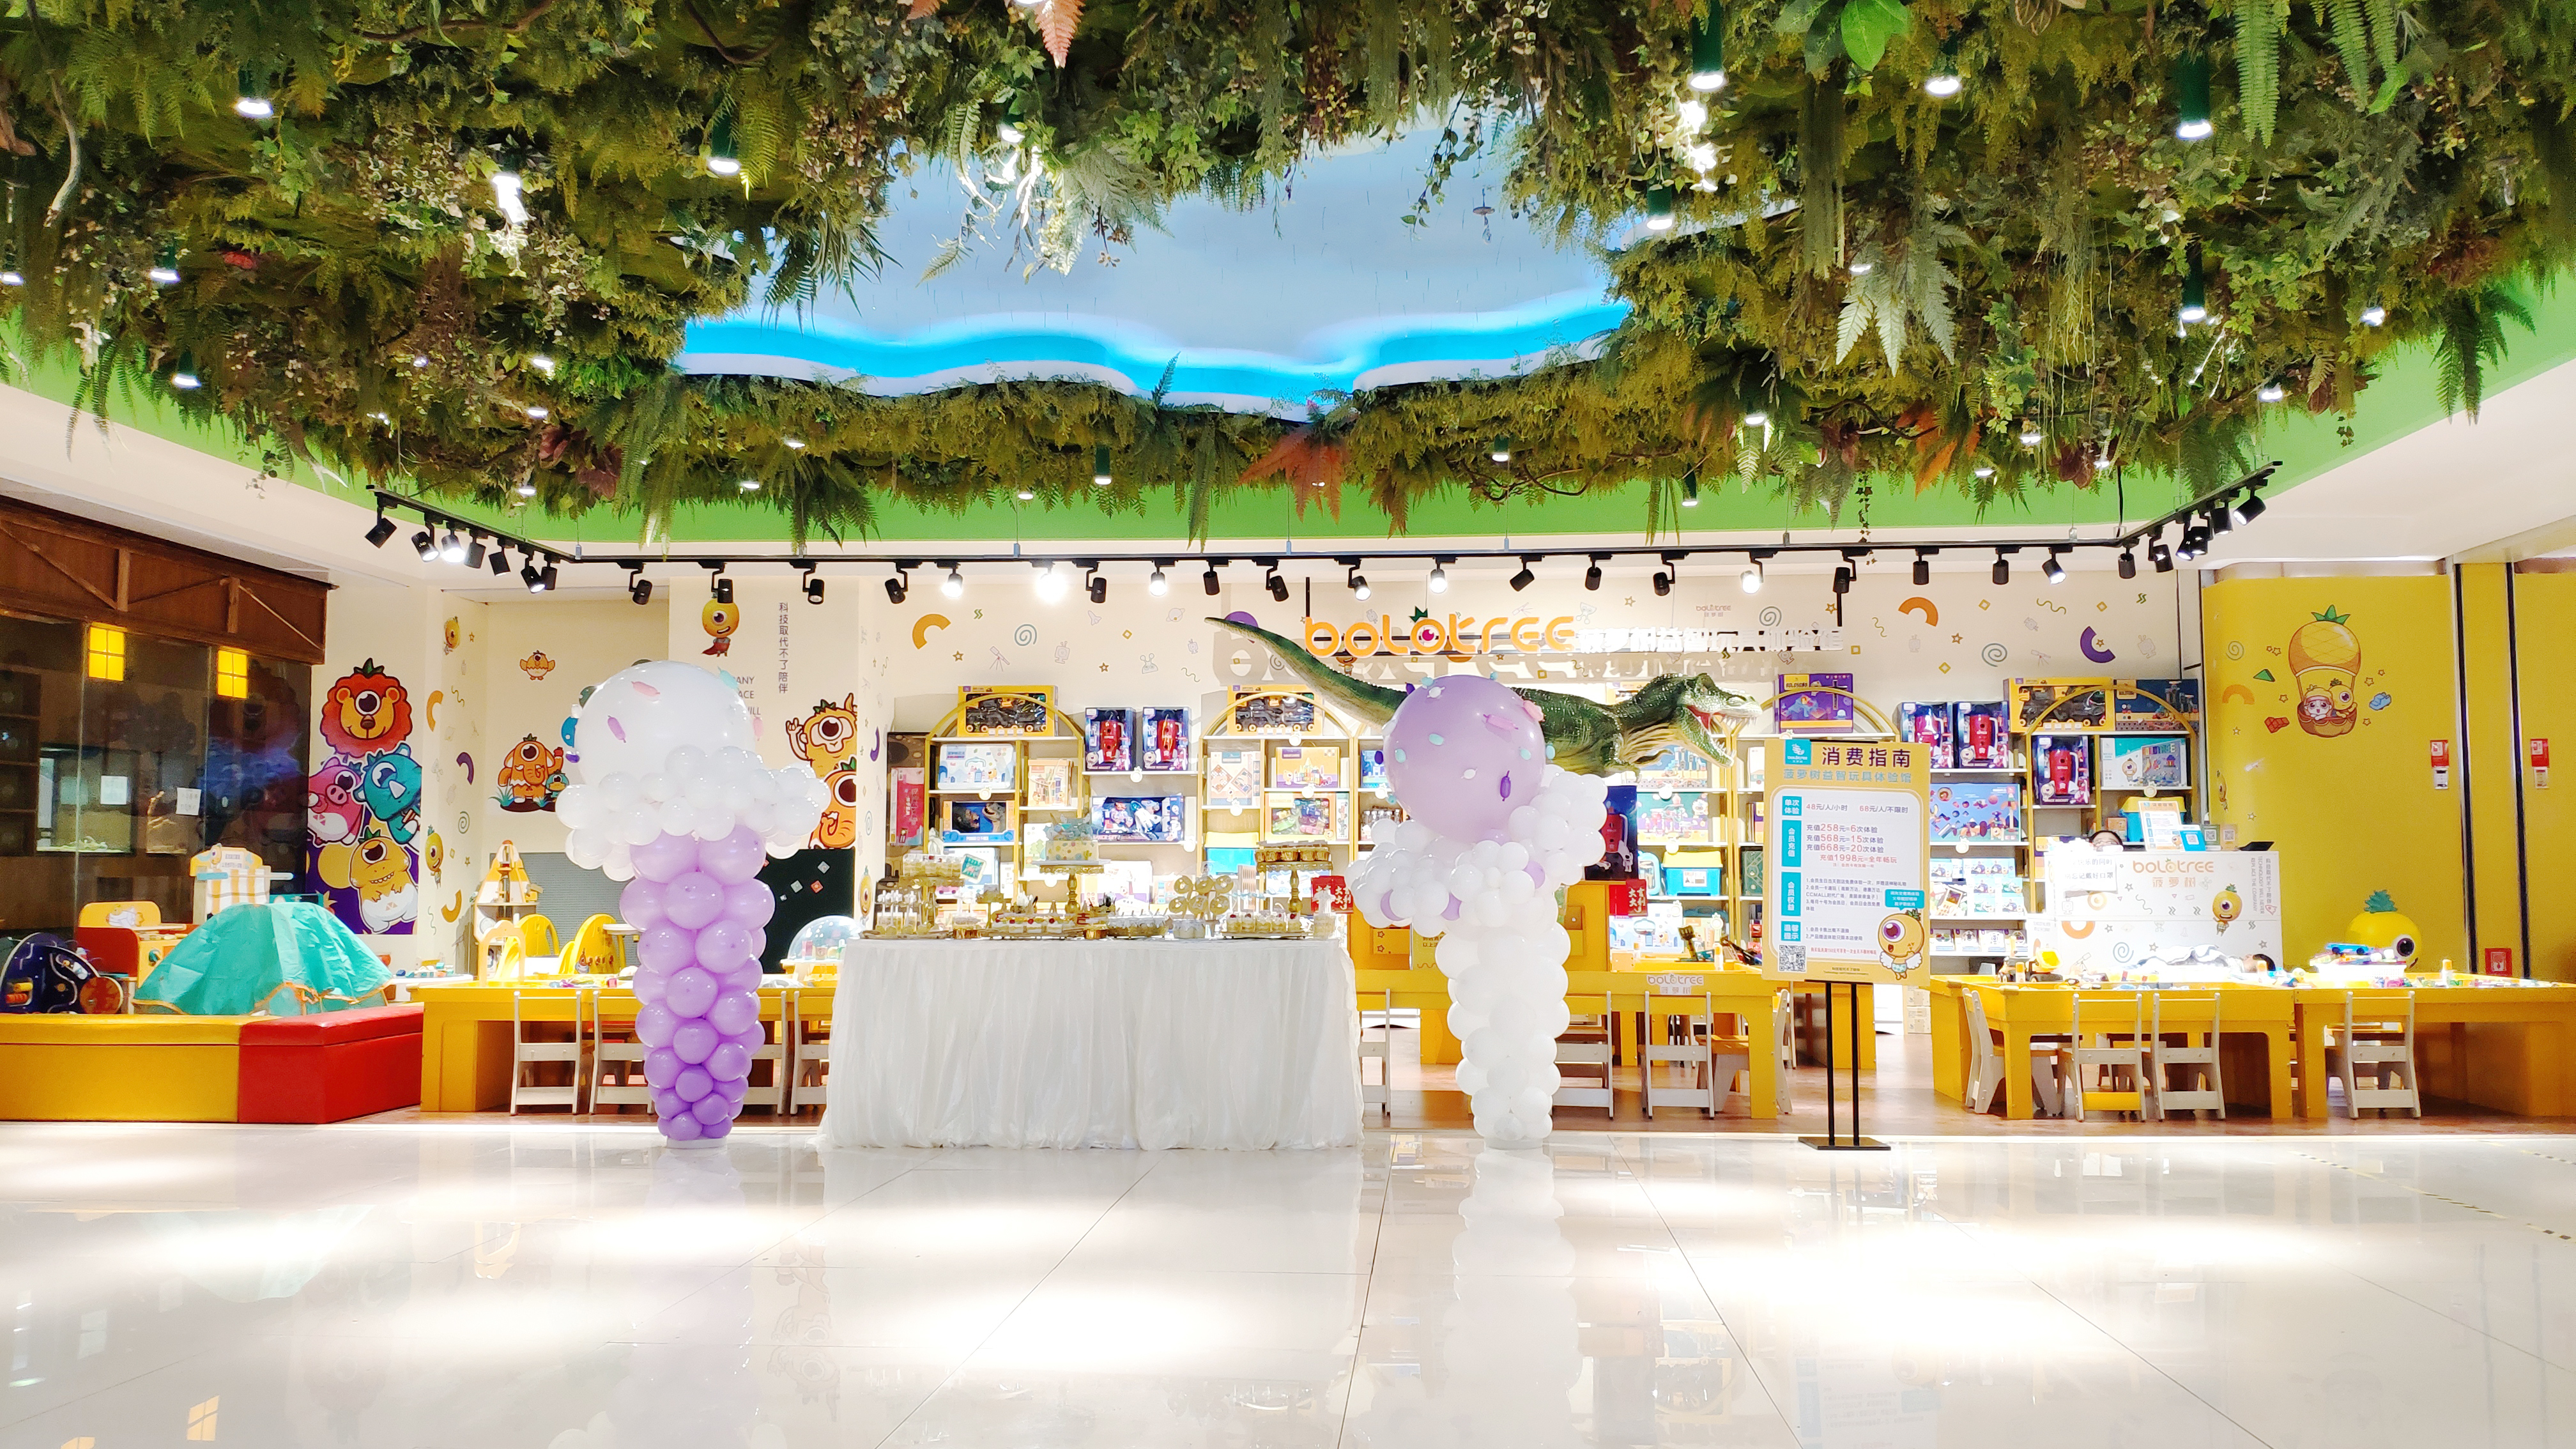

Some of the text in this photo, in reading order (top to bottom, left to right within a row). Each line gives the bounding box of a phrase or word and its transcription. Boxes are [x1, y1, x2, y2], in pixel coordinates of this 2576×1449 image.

[778, 602, 789, 694] 科技取代不了陪伴
[1822, 746, 1911, 768] 消费指南
[1784, 769, 1912, 783] 菠萝树益智玩具体验馆
[1806, 803, 1908, 814] 48元/人/小时 68元/人/不限时
[1806, 824, 1878, 834] 充值258元=6次体验
[1806, 834, 1883, 844] 充值568元=15次体验
[1806, 843, 1884, 854] 充值668元=20次体验
[1820, 854, 1897, 864] 充值1998元=全年畅玩
[2152, 877, 2196, 887] 菠萝树
